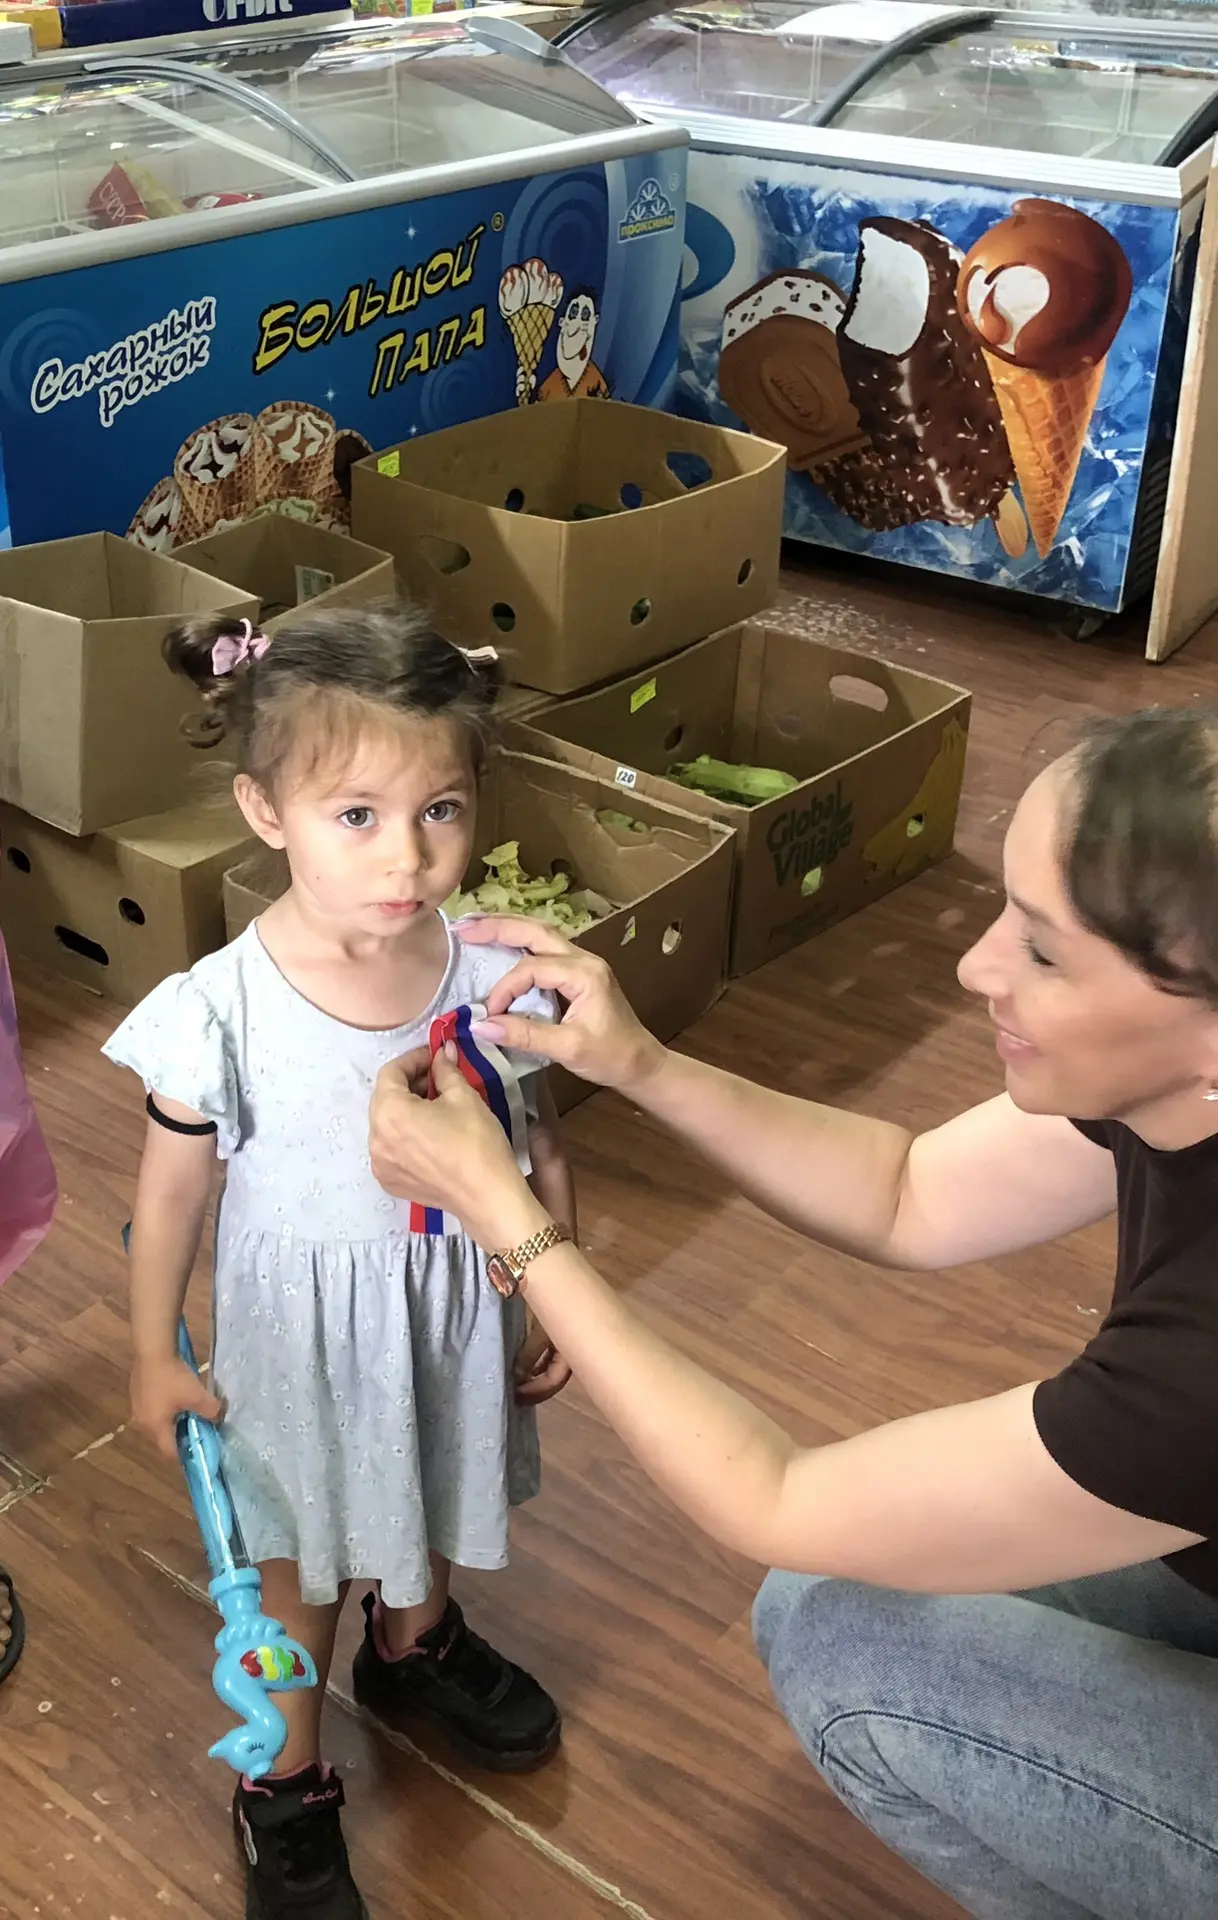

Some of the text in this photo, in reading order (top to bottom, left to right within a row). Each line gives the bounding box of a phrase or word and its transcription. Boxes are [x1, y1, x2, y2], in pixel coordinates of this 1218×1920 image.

[33, 299, 215, 411] Сахарный
[101, 337, 209, 425] рожок
[368, 305, 486, 396] ПАПА
[617, 771, 635, 785] 120
[766, 778, 855, 853] Global
[772, 821, 854, 888] Village
